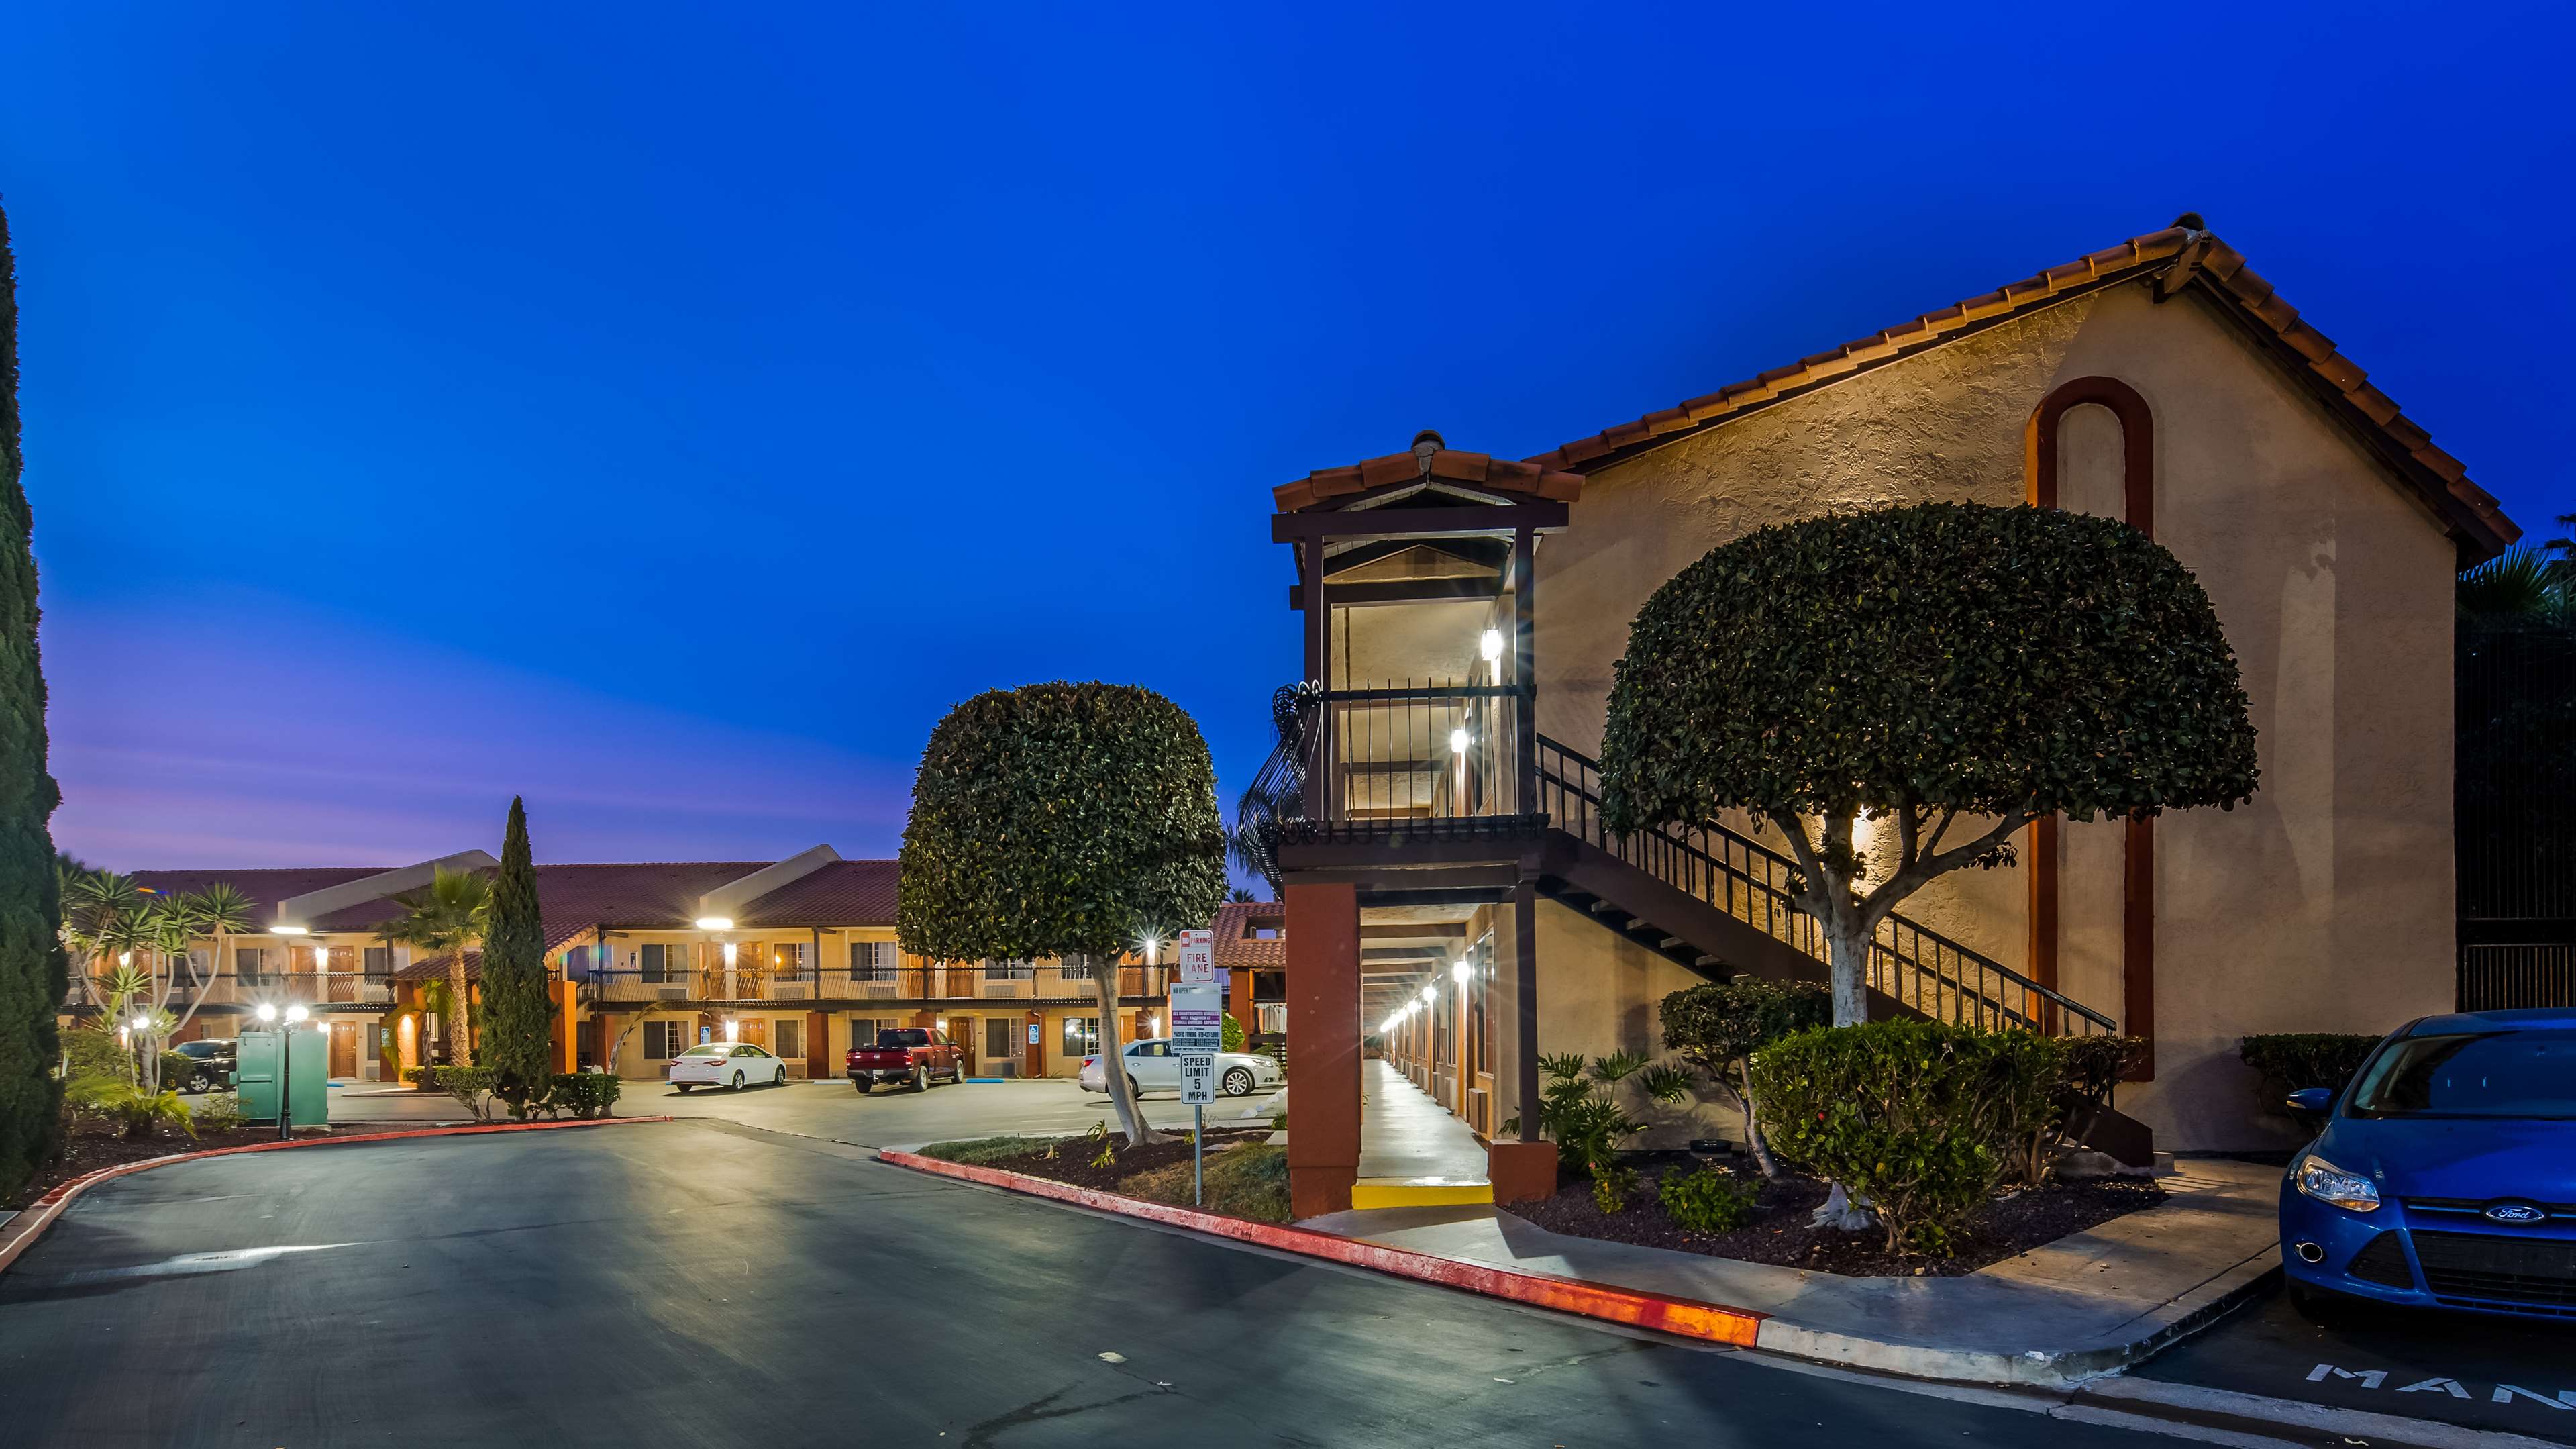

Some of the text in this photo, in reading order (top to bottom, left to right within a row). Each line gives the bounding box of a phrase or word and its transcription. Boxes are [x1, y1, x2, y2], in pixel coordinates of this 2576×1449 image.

[1187, 953, 1207, 962] FIRE
[1184, 1057, 1210, 1066] SPEED
[1185, 1067, 1209, 1077] LIMIT
[1194, 1078, 1201, 1090] 5
[1188, 1091, 1207, 1101] MPH
[2498, 1208, 2530, 1219] Ford
[2306, 1364, 2576, 1411] MAN
